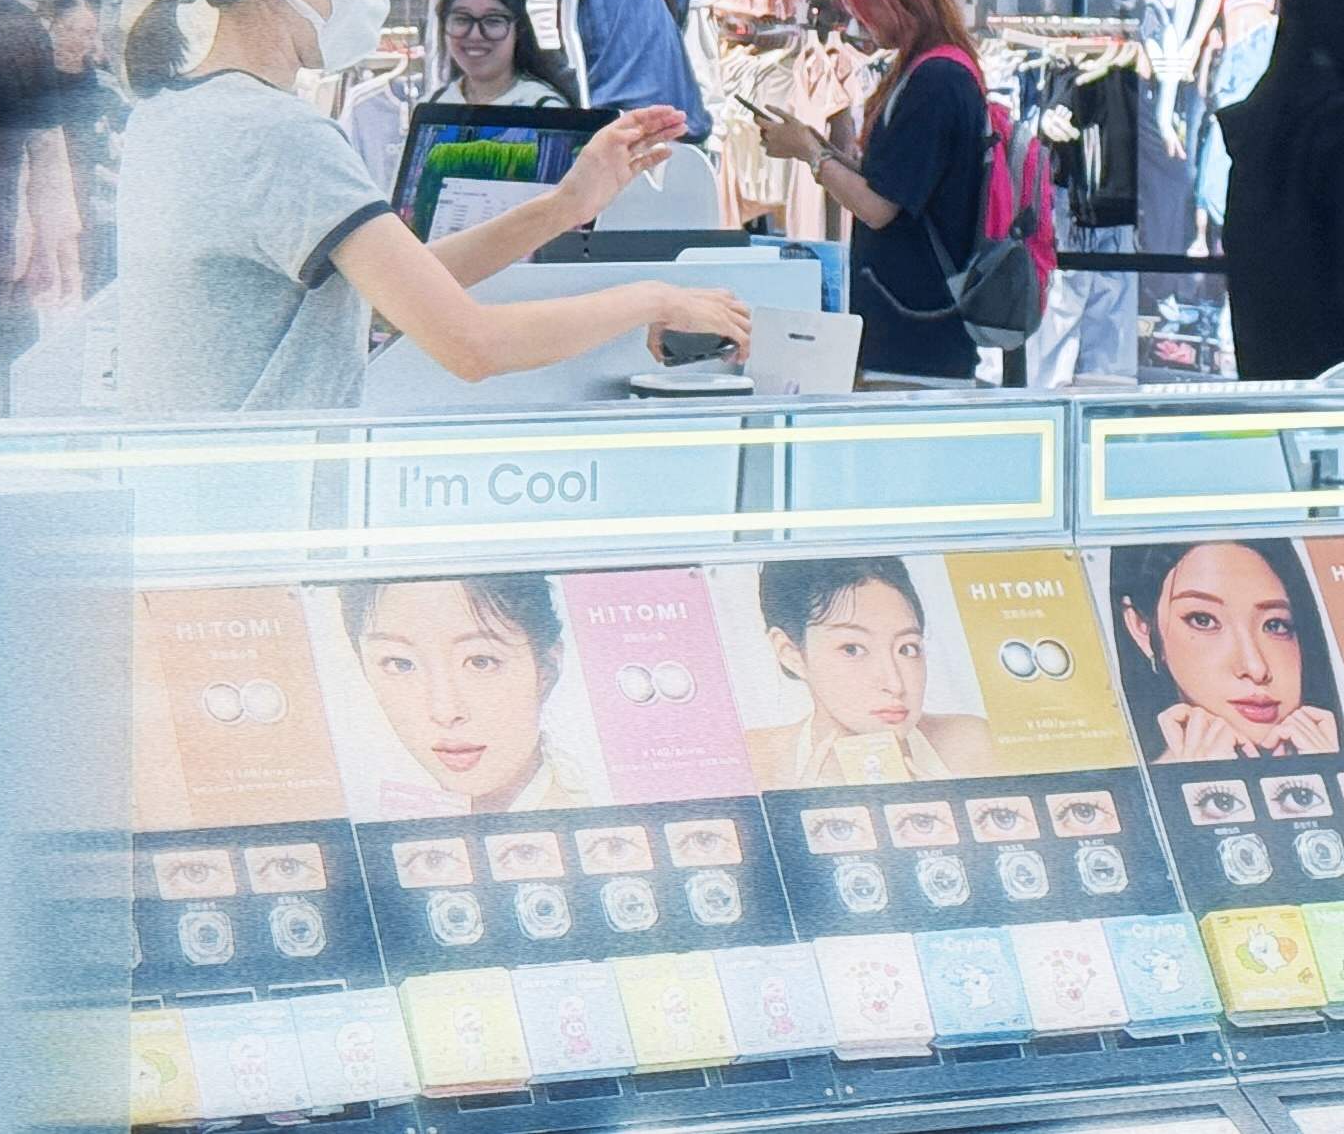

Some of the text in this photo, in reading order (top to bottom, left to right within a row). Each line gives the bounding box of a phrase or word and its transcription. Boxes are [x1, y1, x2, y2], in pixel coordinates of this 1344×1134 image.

[400, 461, 598, 507] I'm Cool
[970, 580, 1066, 601] HITOMI
[588, 601, 689, 625] HITOMI
[175, 617, 283, 643] HITOMI
